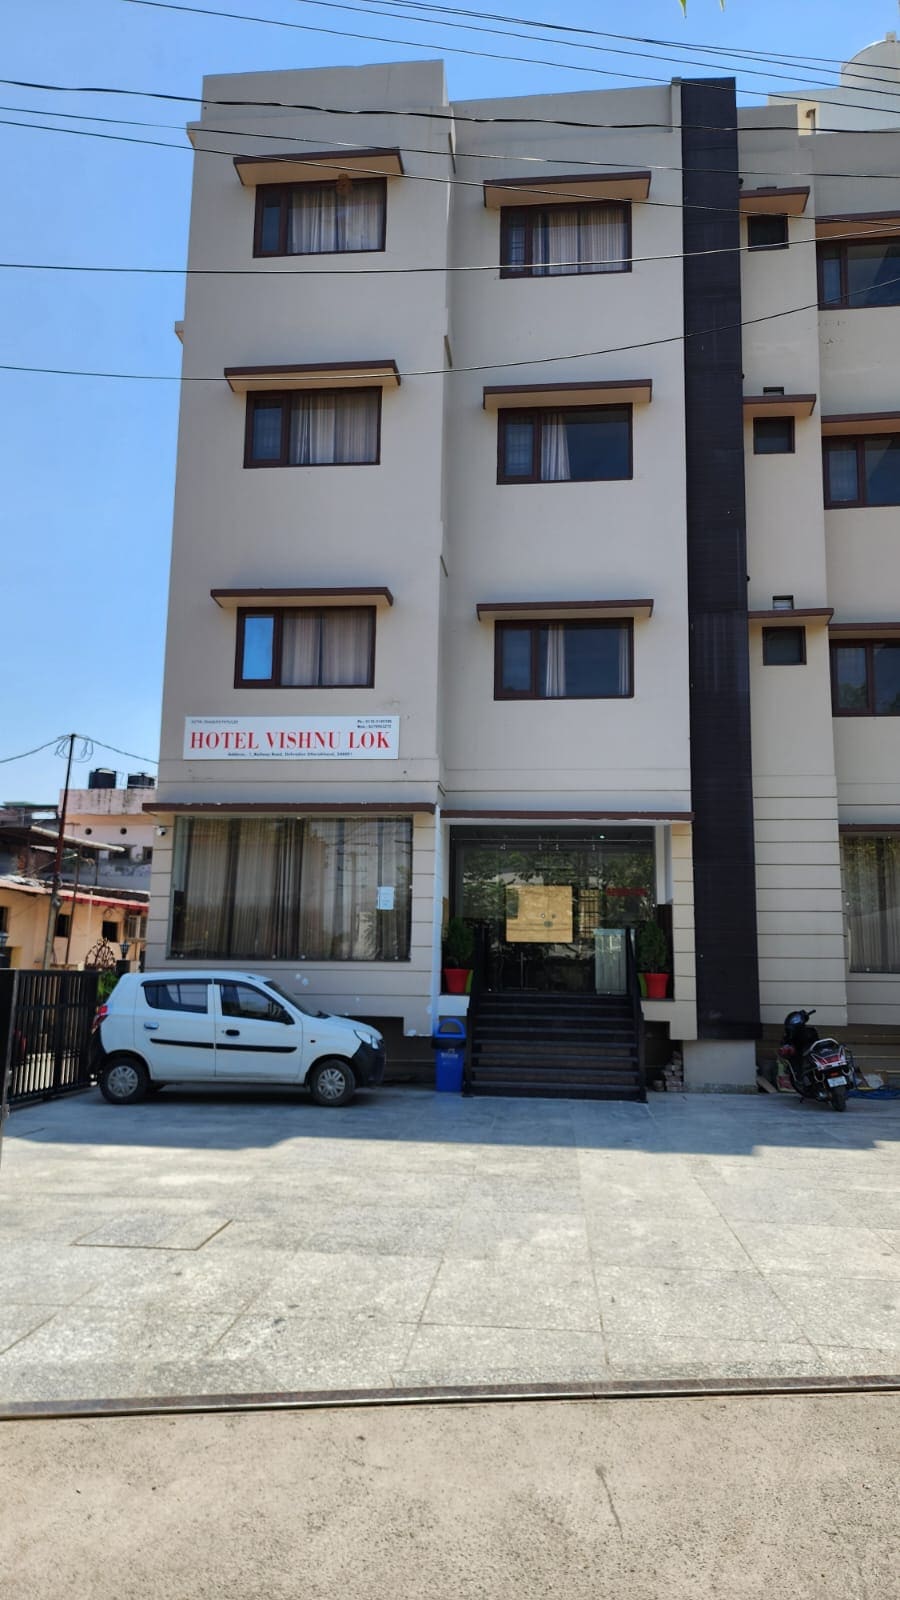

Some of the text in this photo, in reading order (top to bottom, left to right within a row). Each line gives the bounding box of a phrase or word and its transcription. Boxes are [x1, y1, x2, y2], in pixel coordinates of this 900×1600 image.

[190, 731, 391, 749] HOTEL VISHNU LOK
